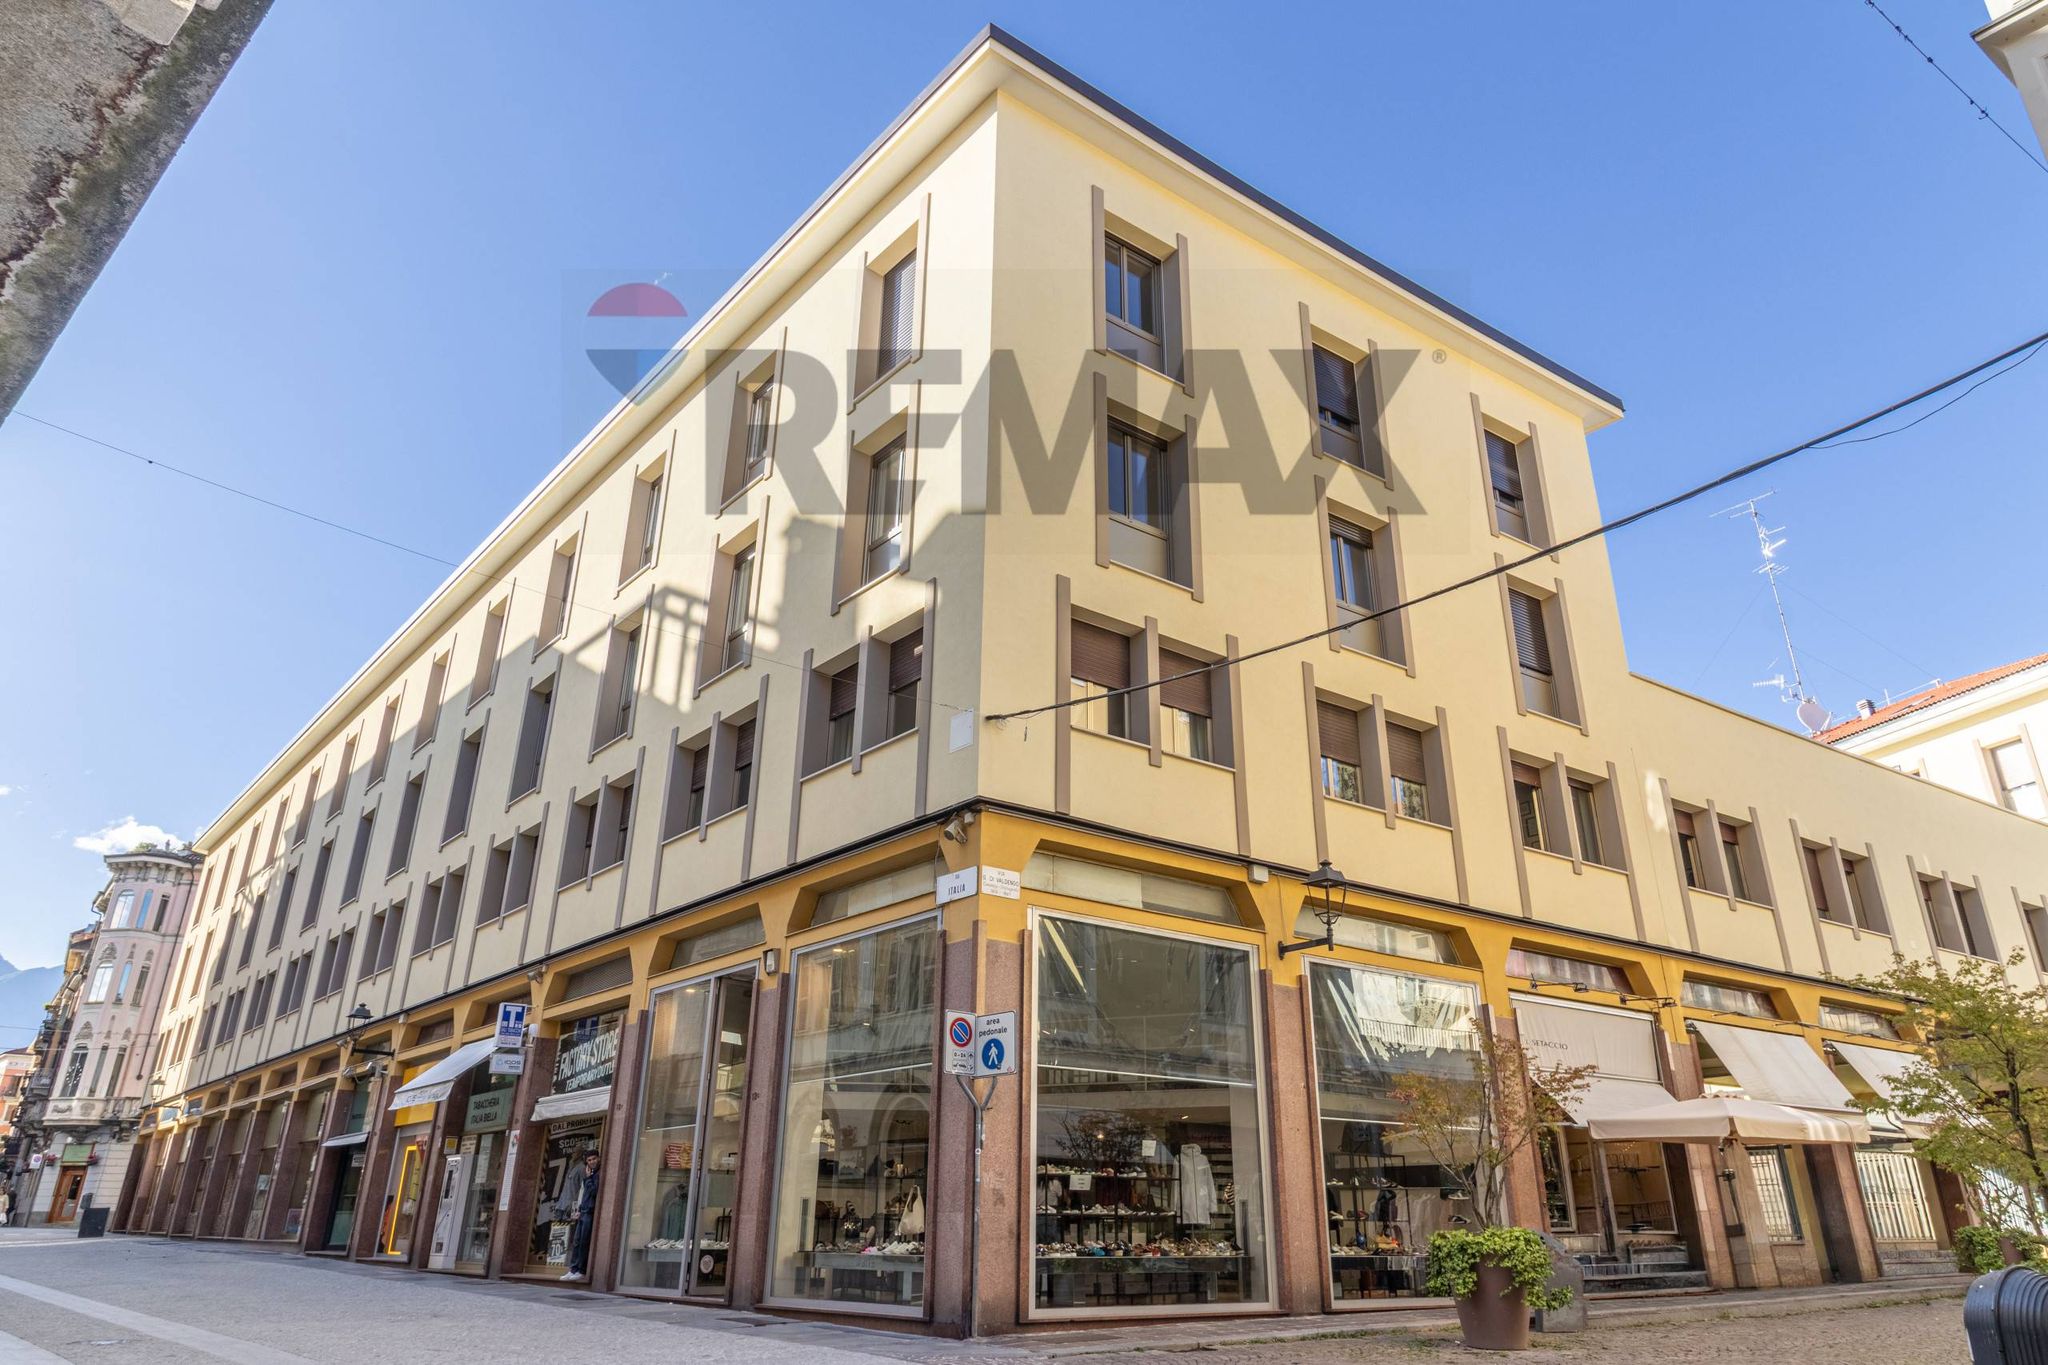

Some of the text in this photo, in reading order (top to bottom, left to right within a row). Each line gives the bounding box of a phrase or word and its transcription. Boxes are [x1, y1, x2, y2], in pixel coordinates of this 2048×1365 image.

[947, 883, 966, 896] ITALIA
[505, 1005, 523, 1028] T
[986, 1018, 1000, 1026] area
[978, 1026, 1008, 1038] pedonale
[1531, 1040, 1569, 1051] SETACCIO
[559, 1028, 620, 1081] FACTORY STORE
